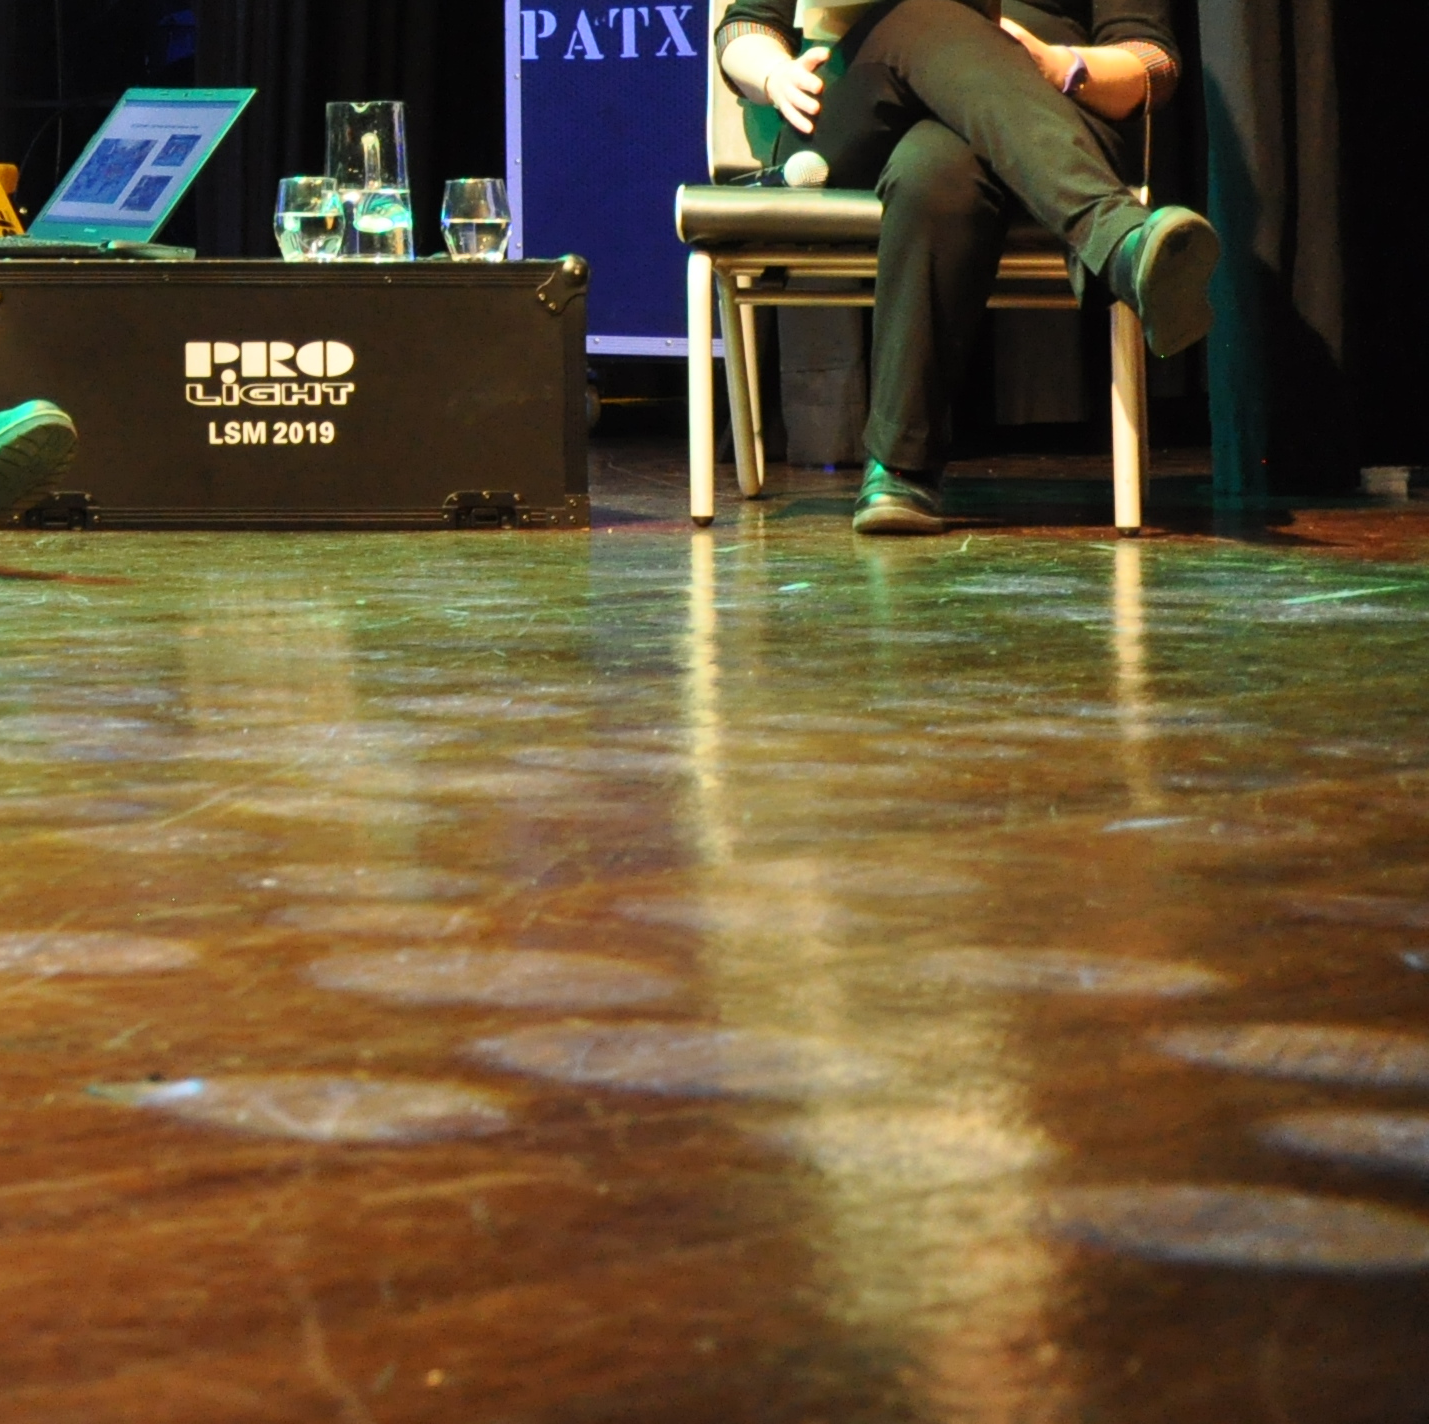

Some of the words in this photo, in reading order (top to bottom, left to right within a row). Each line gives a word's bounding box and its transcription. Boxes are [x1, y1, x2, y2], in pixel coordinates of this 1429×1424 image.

[185, 340, 355, 378] PRO
[208, 421, 267, 445] LSM
[272, 421, 336, 445] 2019
